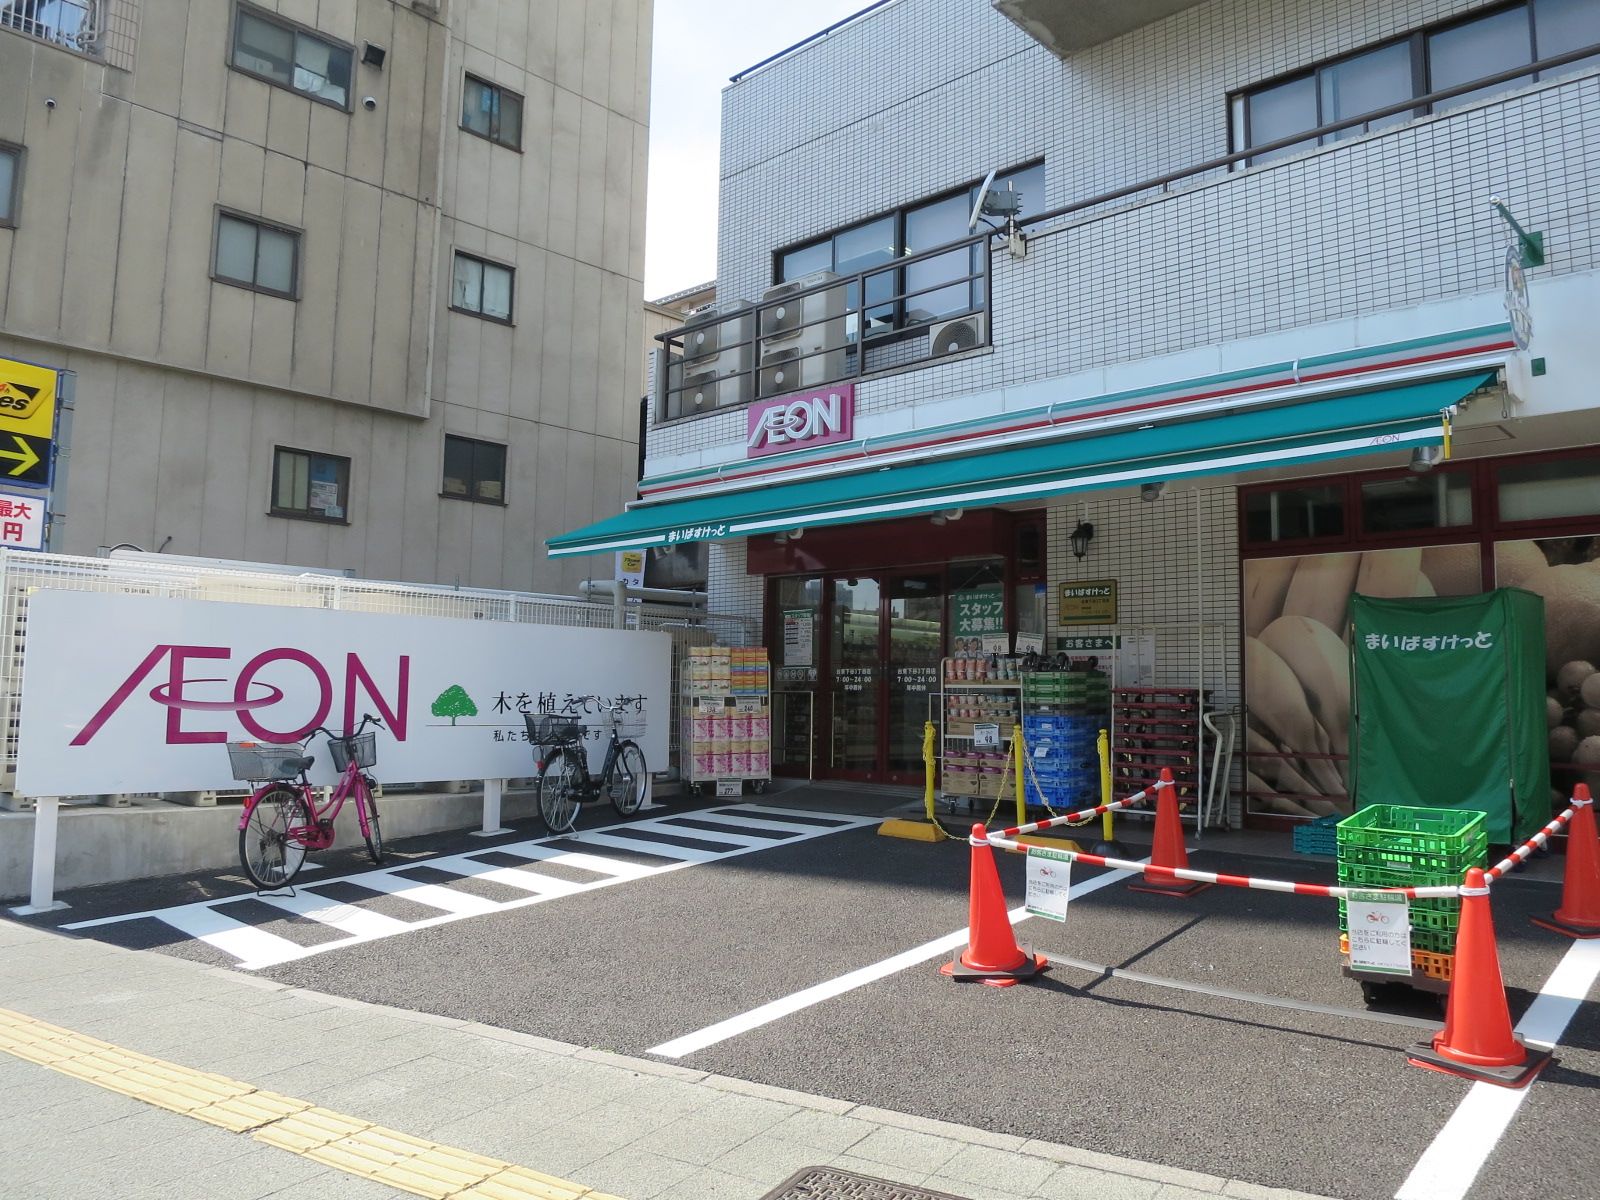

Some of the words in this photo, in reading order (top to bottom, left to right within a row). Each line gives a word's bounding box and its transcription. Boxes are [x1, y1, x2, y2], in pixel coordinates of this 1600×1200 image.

[3, 522, 23, 542] 円
[668, 524, 726, 543] まいばすけっと
[1064, 587, 1111, 597] まいばすけっと
[959, 601, 1003, 616] スタッフ
[1066, 639, 1114, 649] お客さまへ
[1365, 632, 1493, 650] まいばすけっと
